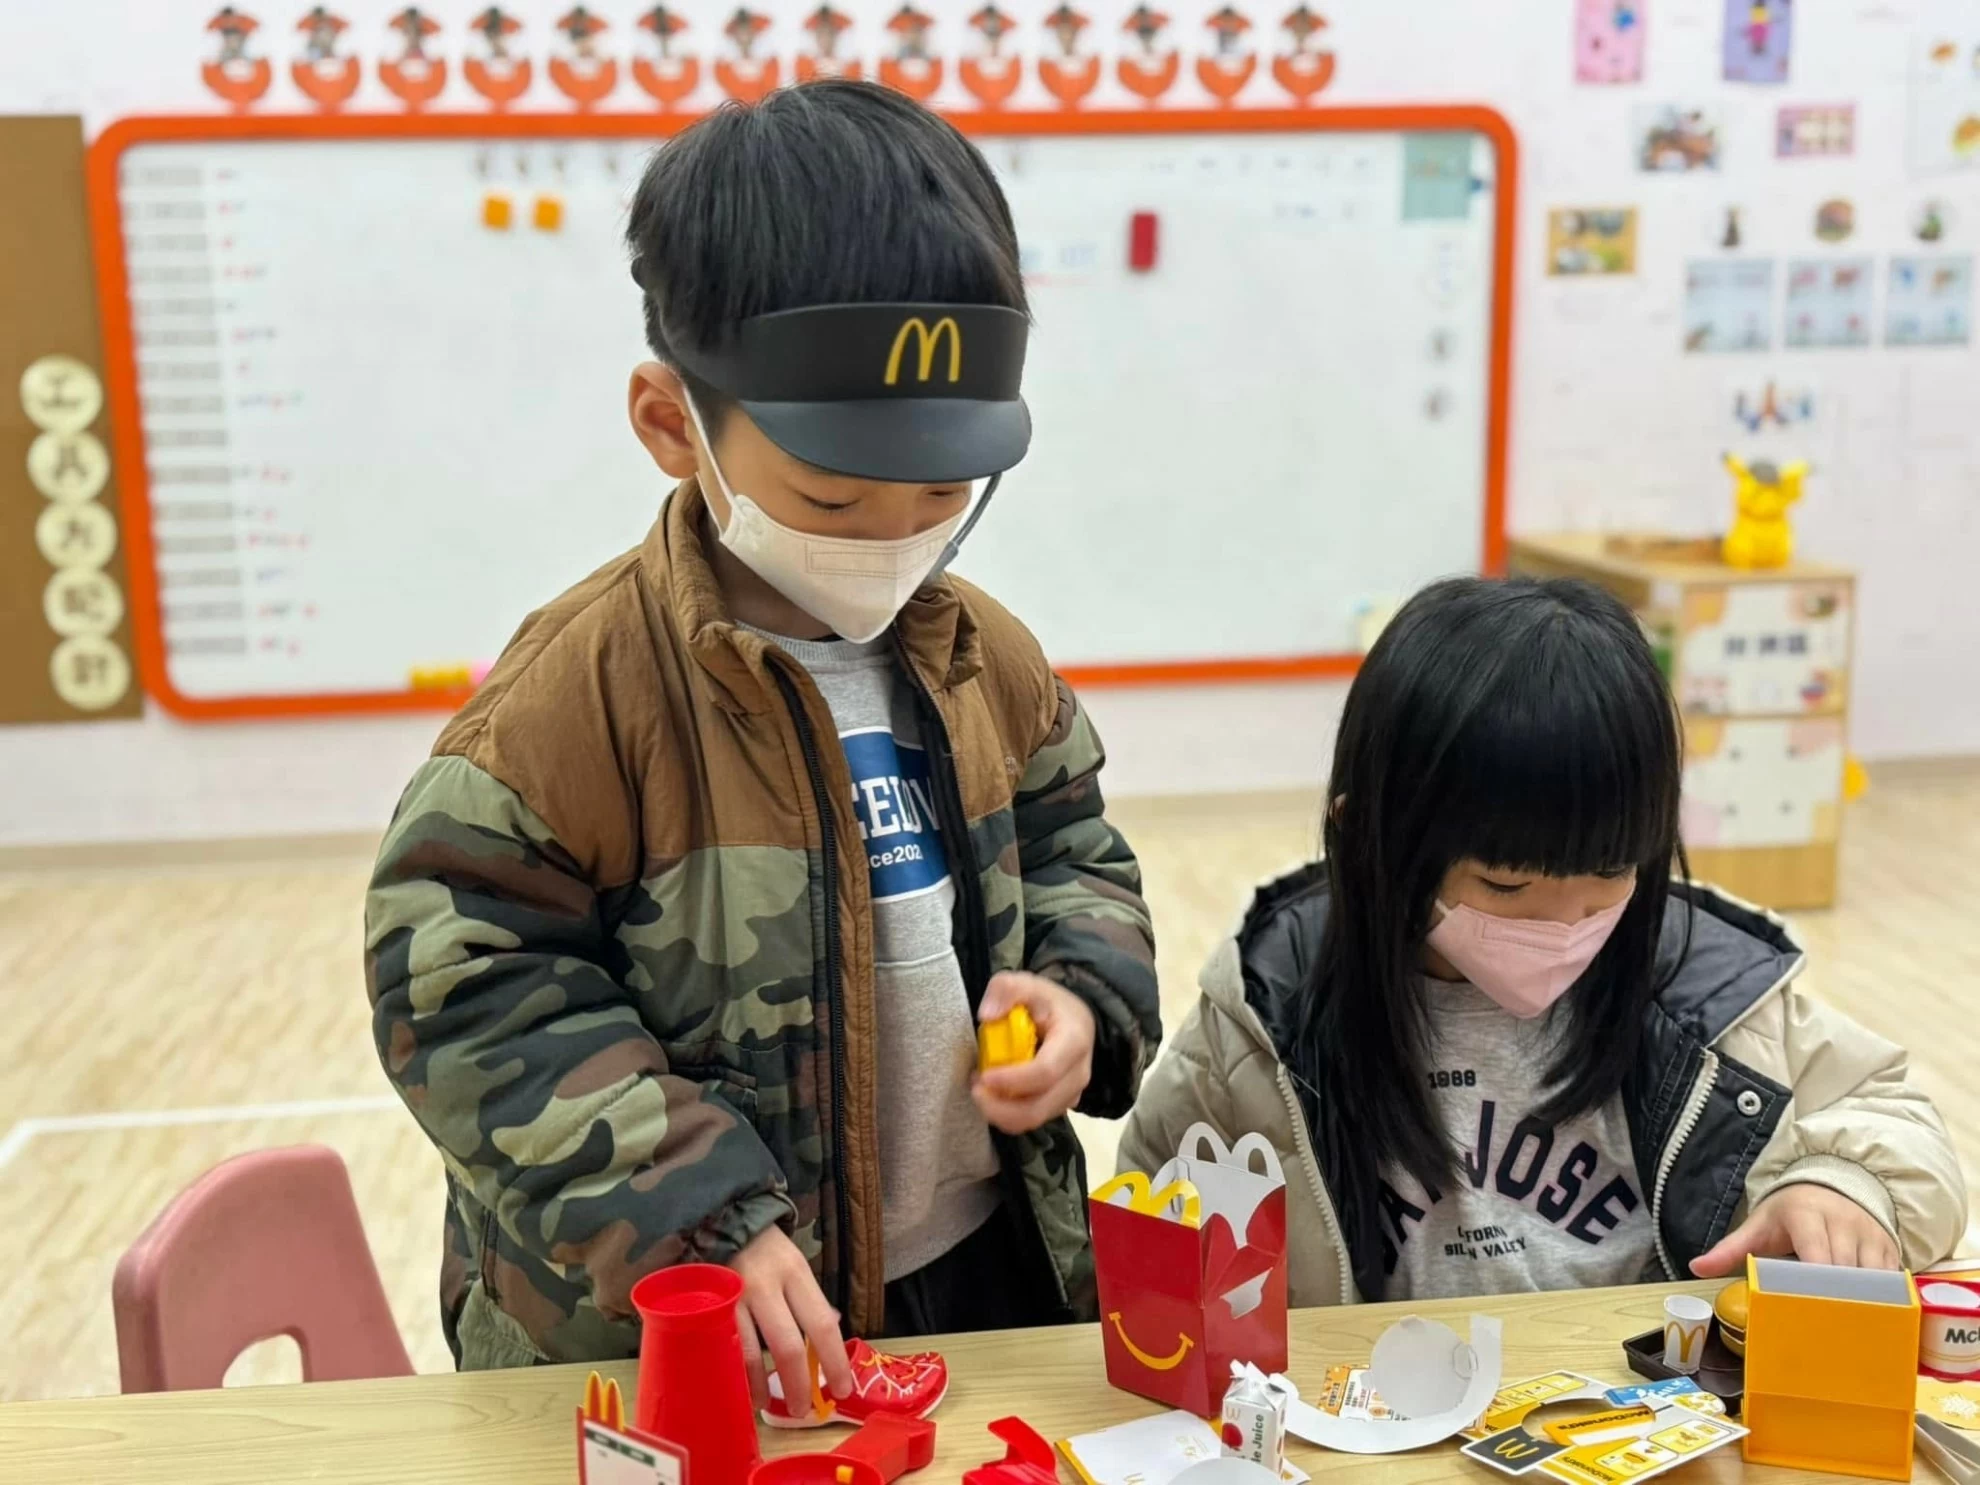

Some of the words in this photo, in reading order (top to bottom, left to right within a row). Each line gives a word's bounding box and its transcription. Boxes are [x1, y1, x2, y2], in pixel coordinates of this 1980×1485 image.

[870, 844, 924, 868] ce202
[1465, 1099, 1639, 1246] JOSE
[1945, 1327, 1980, 1344] Mc
[1252, 1414, 1264, 1450] Juice
